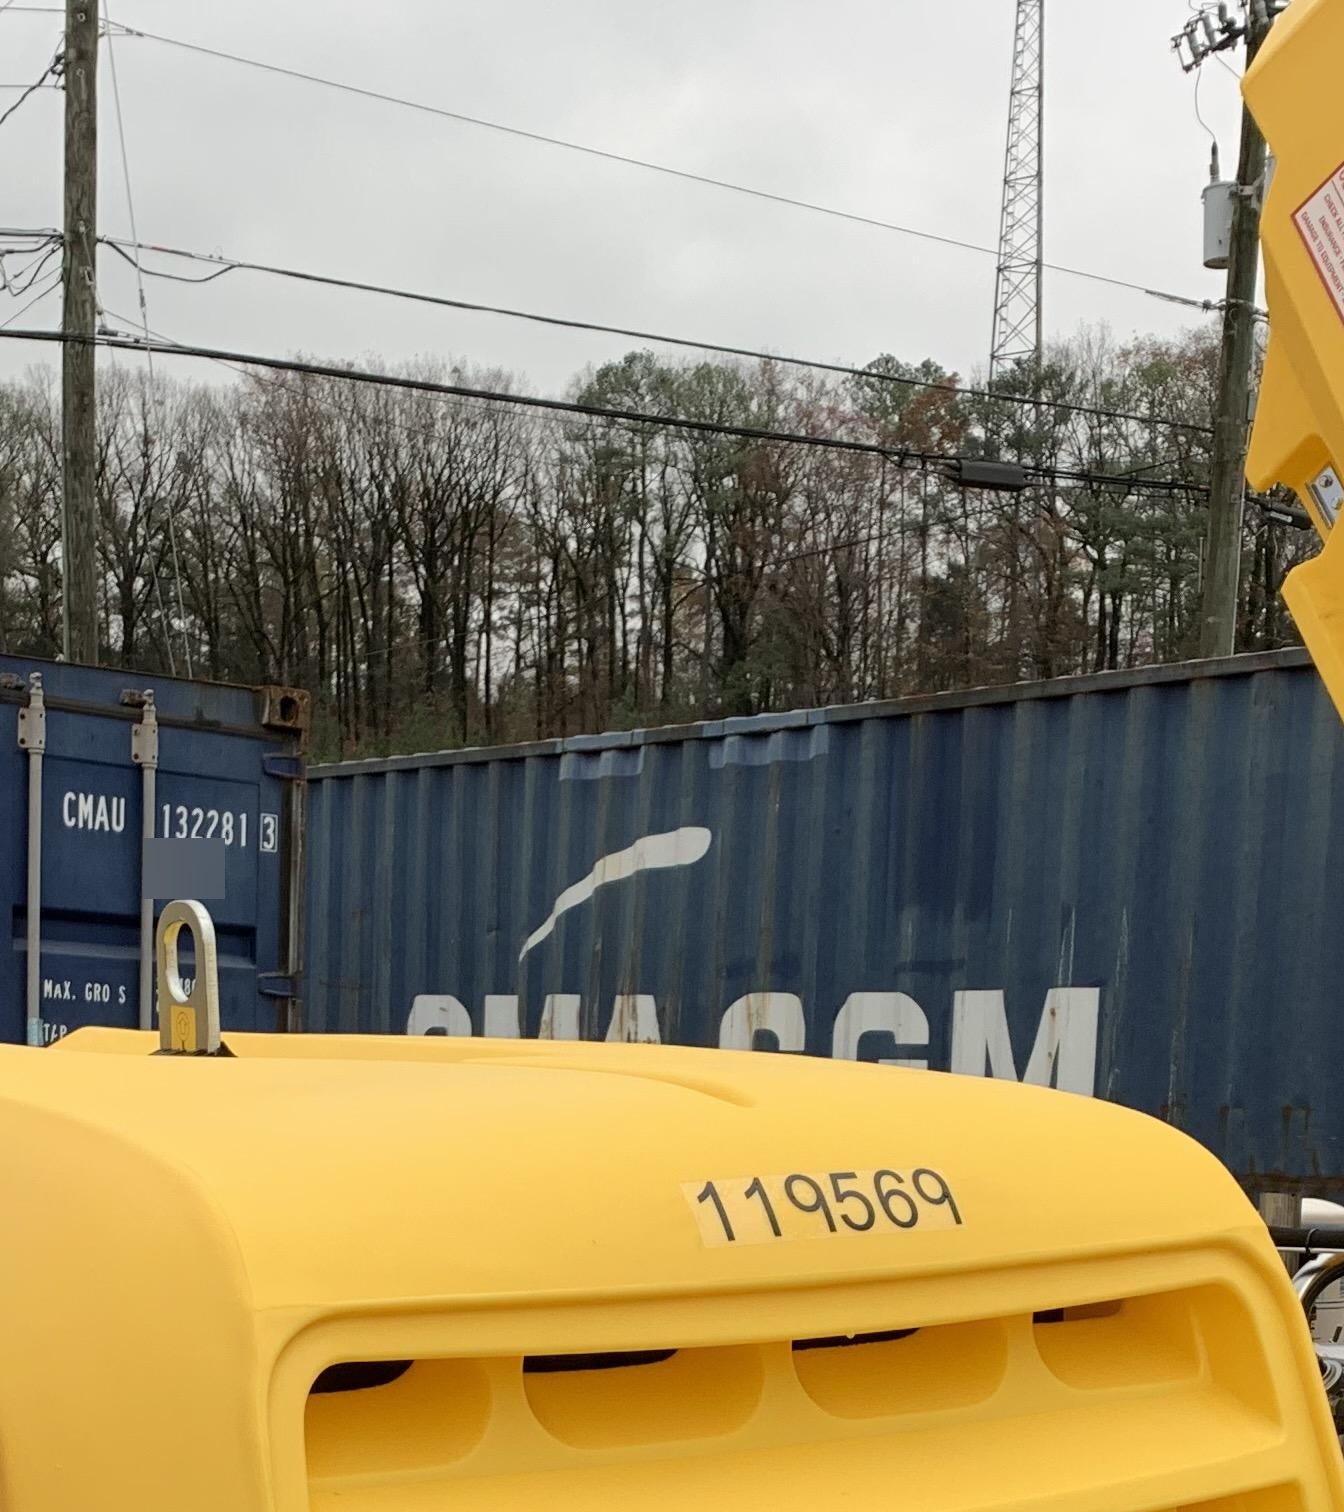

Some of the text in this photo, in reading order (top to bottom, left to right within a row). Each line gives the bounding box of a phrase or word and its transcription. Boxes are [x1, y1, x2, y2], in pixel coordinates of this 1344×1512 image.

[1322, 193, 1339, 219] CHECK
[1334, 217, 1343, 230] ALL
[1300, 210, 1318, 241] DAMAGE
[1314, 240, 1324, 253] TO
[1319, 250, 1344, 293] EQUIPMENT
[62, 791, 275, 850] CMAU 132281 3
[696, 1167, 963, 1242] 119569
